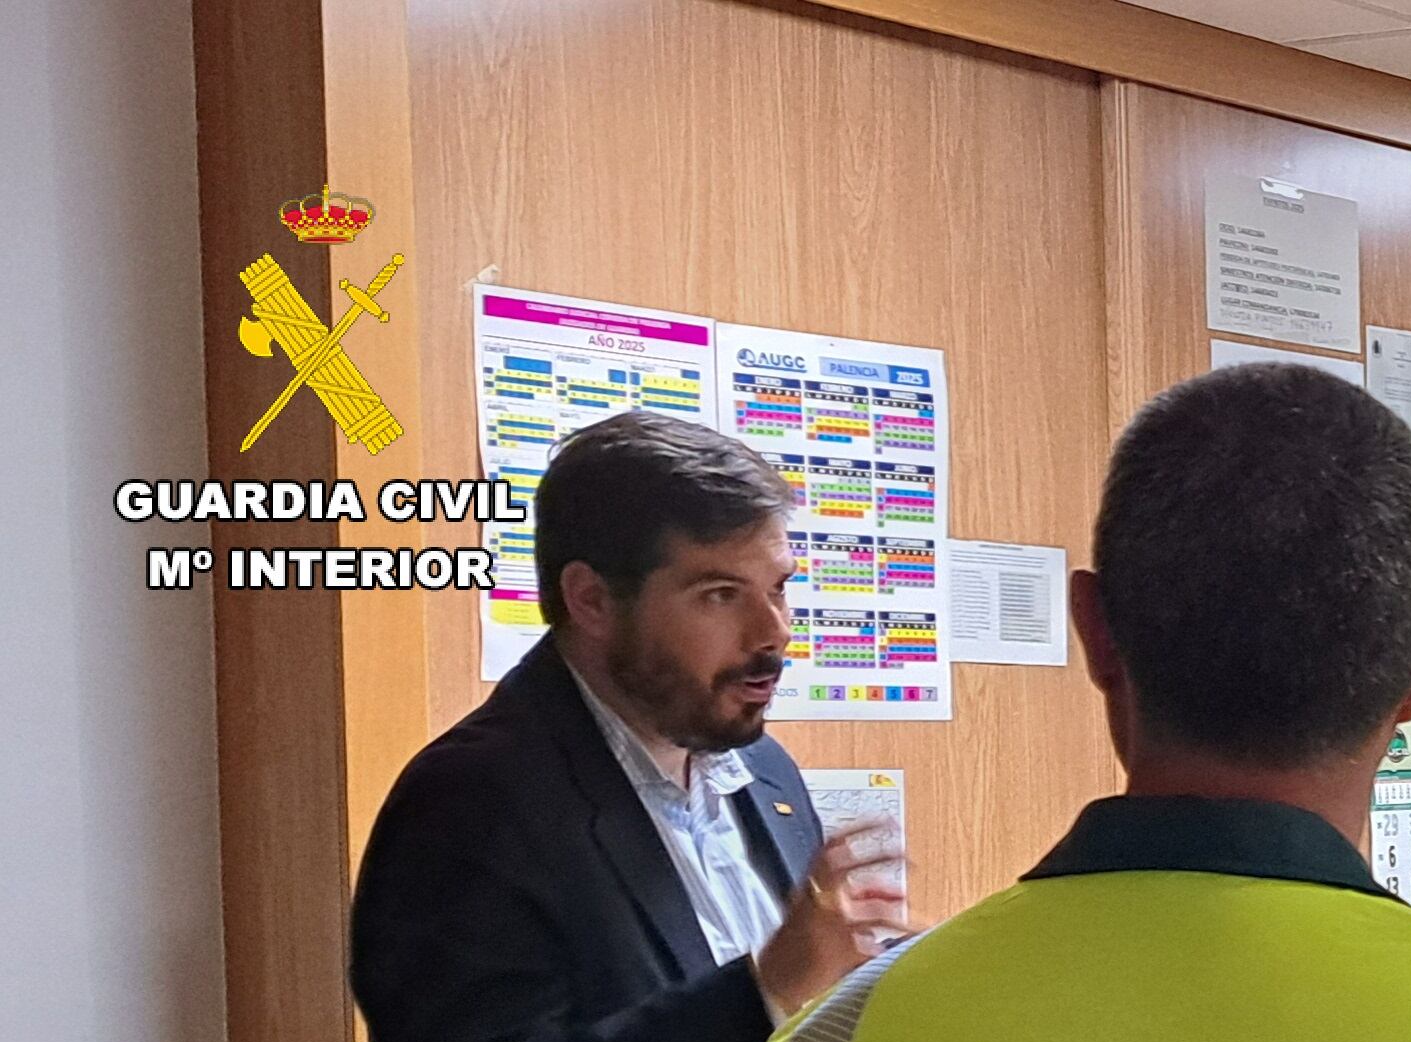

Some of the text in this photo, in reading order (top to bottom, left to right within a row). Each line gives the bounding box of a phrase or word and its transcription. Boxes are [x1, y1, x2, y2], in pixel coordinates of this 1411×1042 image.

[588, 334, 645, 353] AÑO 2025
[758, 352, 805, 368] AUGC
[1384, 814, 1398, 836] 29
[1389, 846, 1396, 867] 6
[1386, 876, 1398, 895] 13
